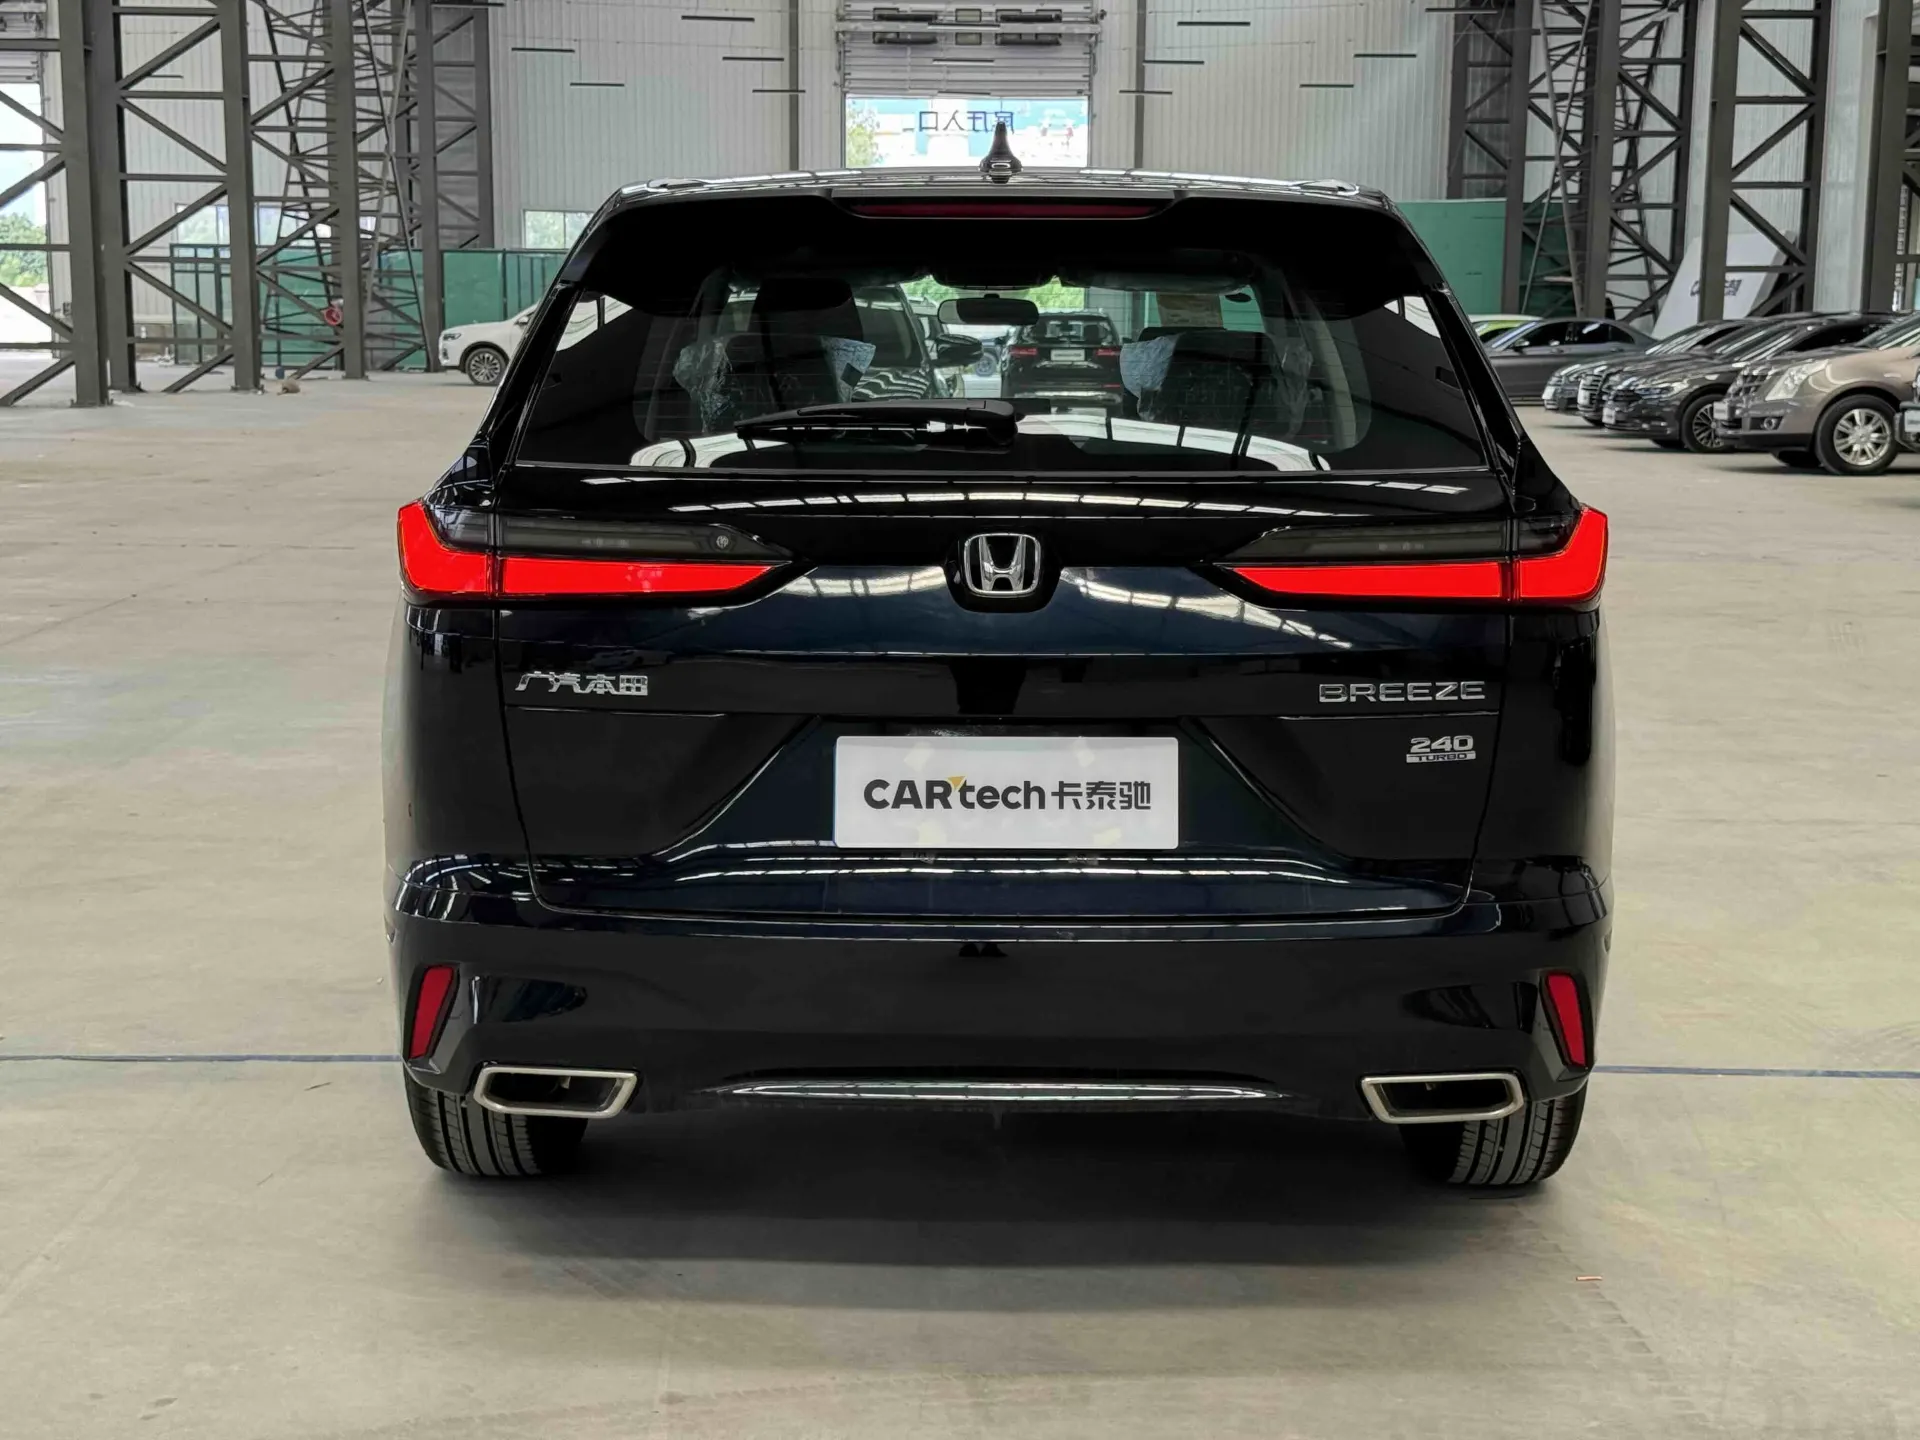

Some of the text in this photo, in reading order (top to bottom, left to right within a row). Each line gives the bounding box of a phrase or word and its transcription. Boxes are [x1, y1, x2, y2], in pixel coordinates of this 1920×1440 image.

[515, 671, 648, 695] 广汽本田
[1319, 679, 1486, 702] BREEZE
[1410, 735, 1474, 753] 240
[1408, 752, 1472, 763] TURBO
[864, 778, 1151, 810] CARtech 卡泰驰
